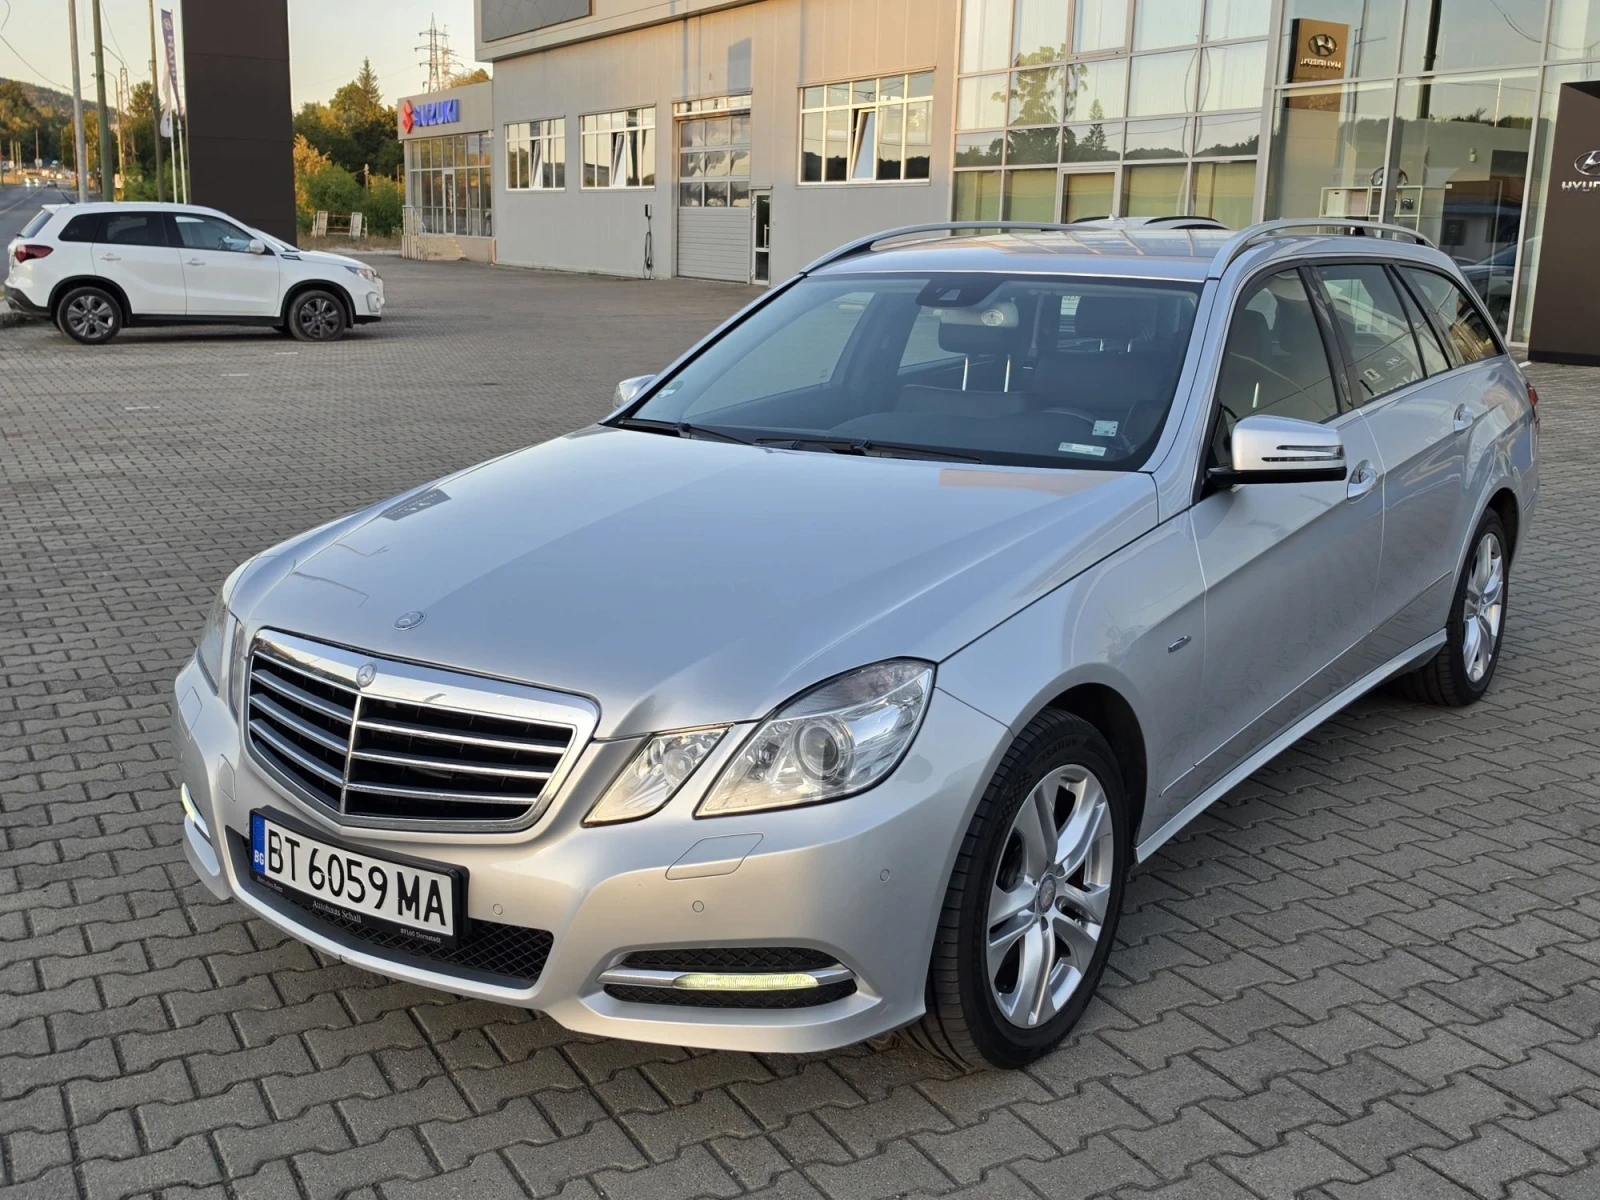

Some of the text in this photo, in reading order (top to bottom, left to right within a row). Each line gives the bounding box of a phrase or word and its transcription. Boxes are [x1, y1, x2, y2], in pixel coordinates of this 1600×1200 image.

[413, 99, 460, 127] SUZUKI
[254, 850, 265, 865] BG
[267, 828, 446, 926] BT 6059 MA
